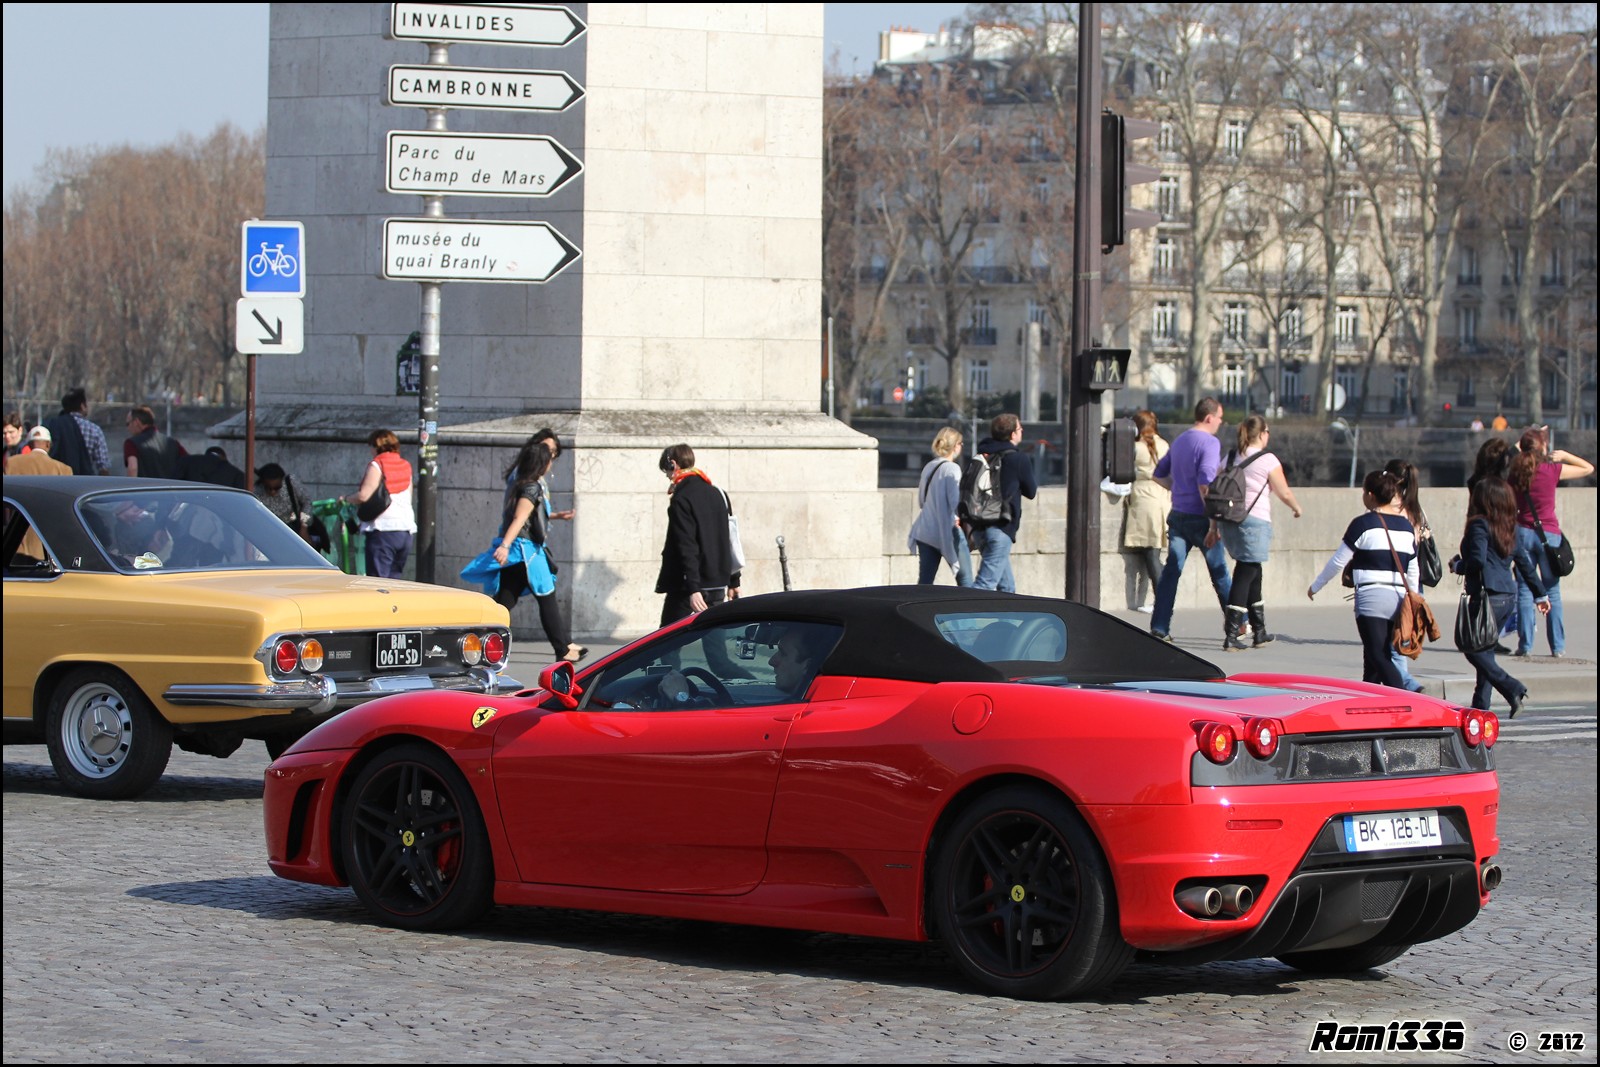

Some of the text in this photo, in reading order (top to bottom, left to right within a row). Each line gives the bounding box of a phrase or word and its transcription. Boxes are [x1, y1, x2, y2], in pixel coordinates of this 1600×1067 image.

[401, 12, 515, 32] INVALIDES
[399, 78, 533, 98] CAMBRONNE
[398, 144, 475, 161] Parc du
[398, 167, 546, 186] Champ de Mars
[396, 231, 480, 247] musée du
[395, 253, 498, 273] quai Branly
[380, 649, 419, 665] 061-SD
